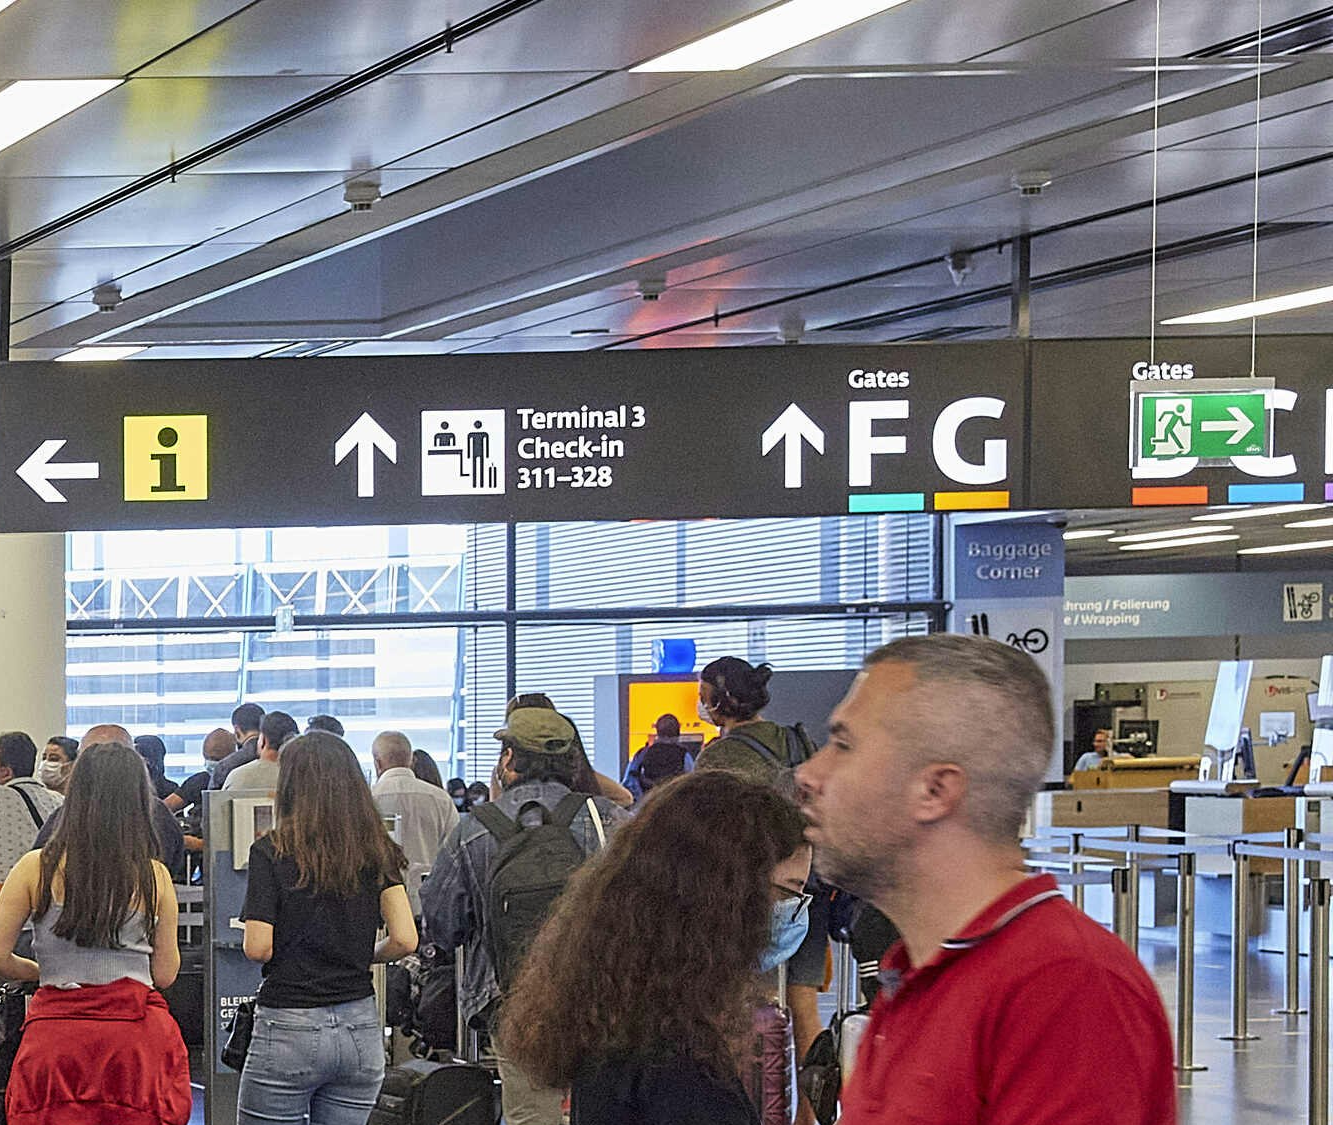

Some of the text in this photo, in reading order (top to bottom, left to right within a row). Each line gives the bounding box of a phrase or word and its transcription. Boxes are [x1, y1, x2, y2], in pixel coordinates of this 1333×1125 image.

[848, 368, 910, 389] Gates
[1132, 362, 1194, 380] Gates
[516, 405, 646, 430] Terminal 3
[517, 433, 625, 460] Check-in
[968, 542, 1052, 560] Baggage
[976, 564, 1042, 580] Corner
[1112, 598, 1170, 613] Folierung
[1081, 613, 1140, 627] Wrapping
